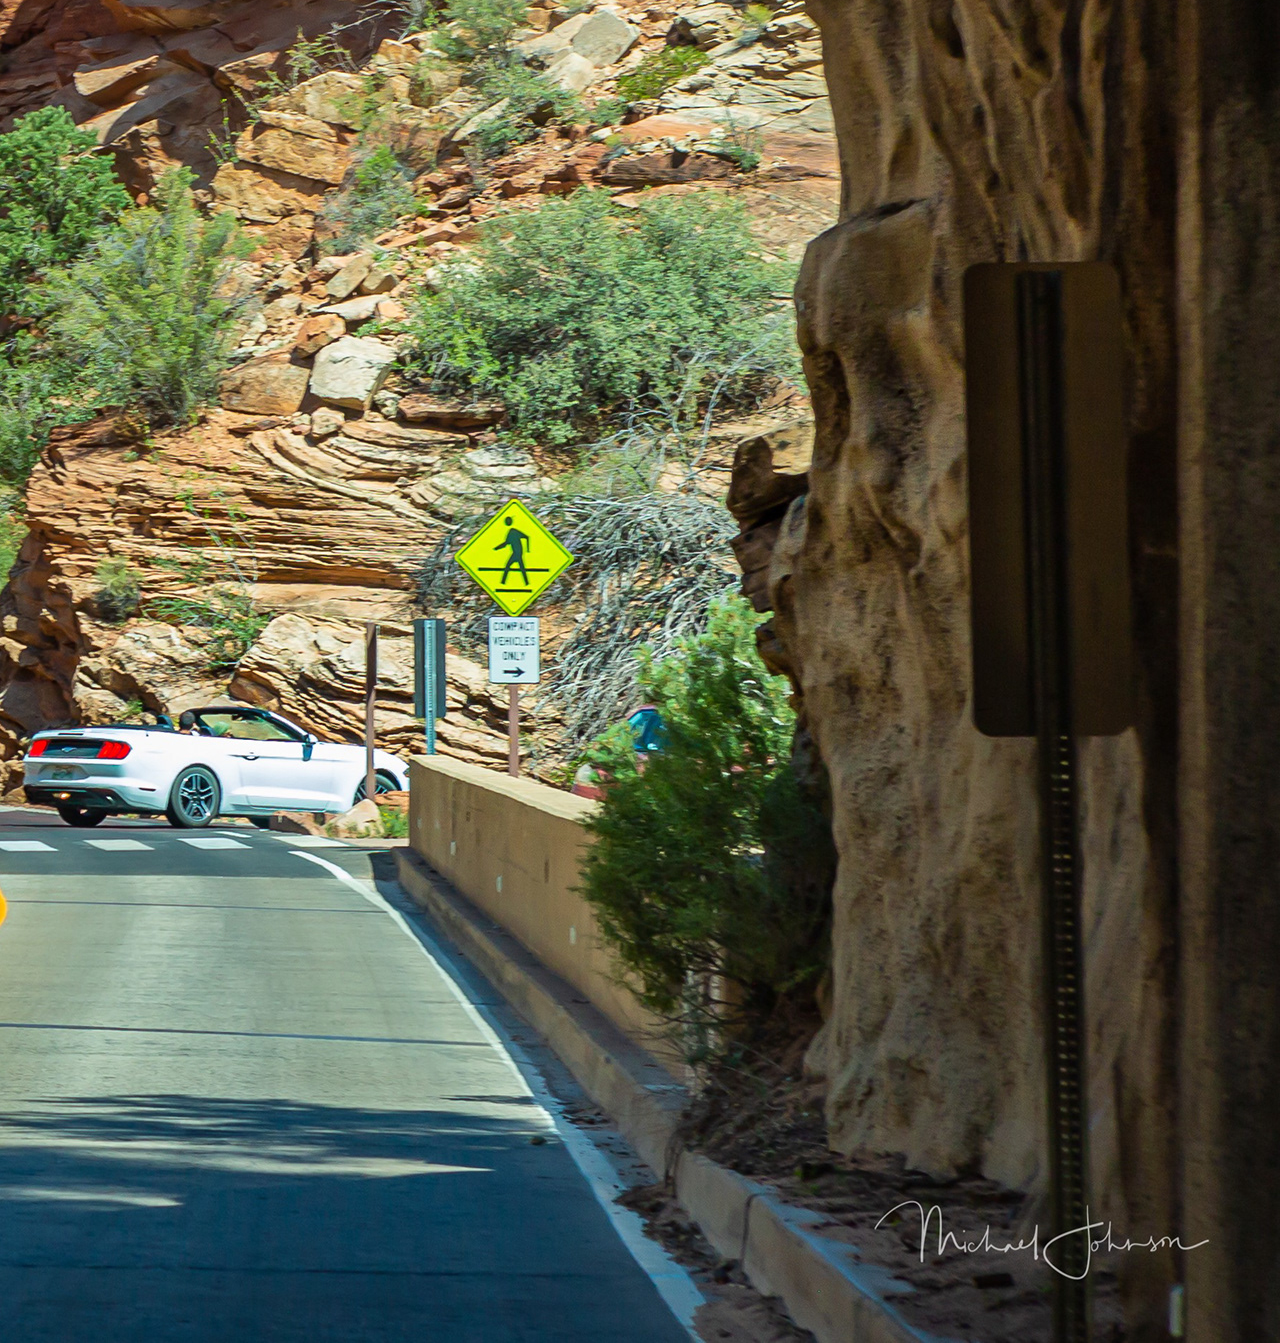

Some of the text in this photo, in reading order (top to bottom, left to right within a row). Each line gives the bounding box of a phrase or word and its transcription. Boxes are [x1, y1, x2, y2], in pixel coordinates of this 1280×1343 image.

[493, 622, 535, 632] COMPACT
[493, 636, 536, 646] VEHICLES
[502, 651, 526, 661] ONLY
